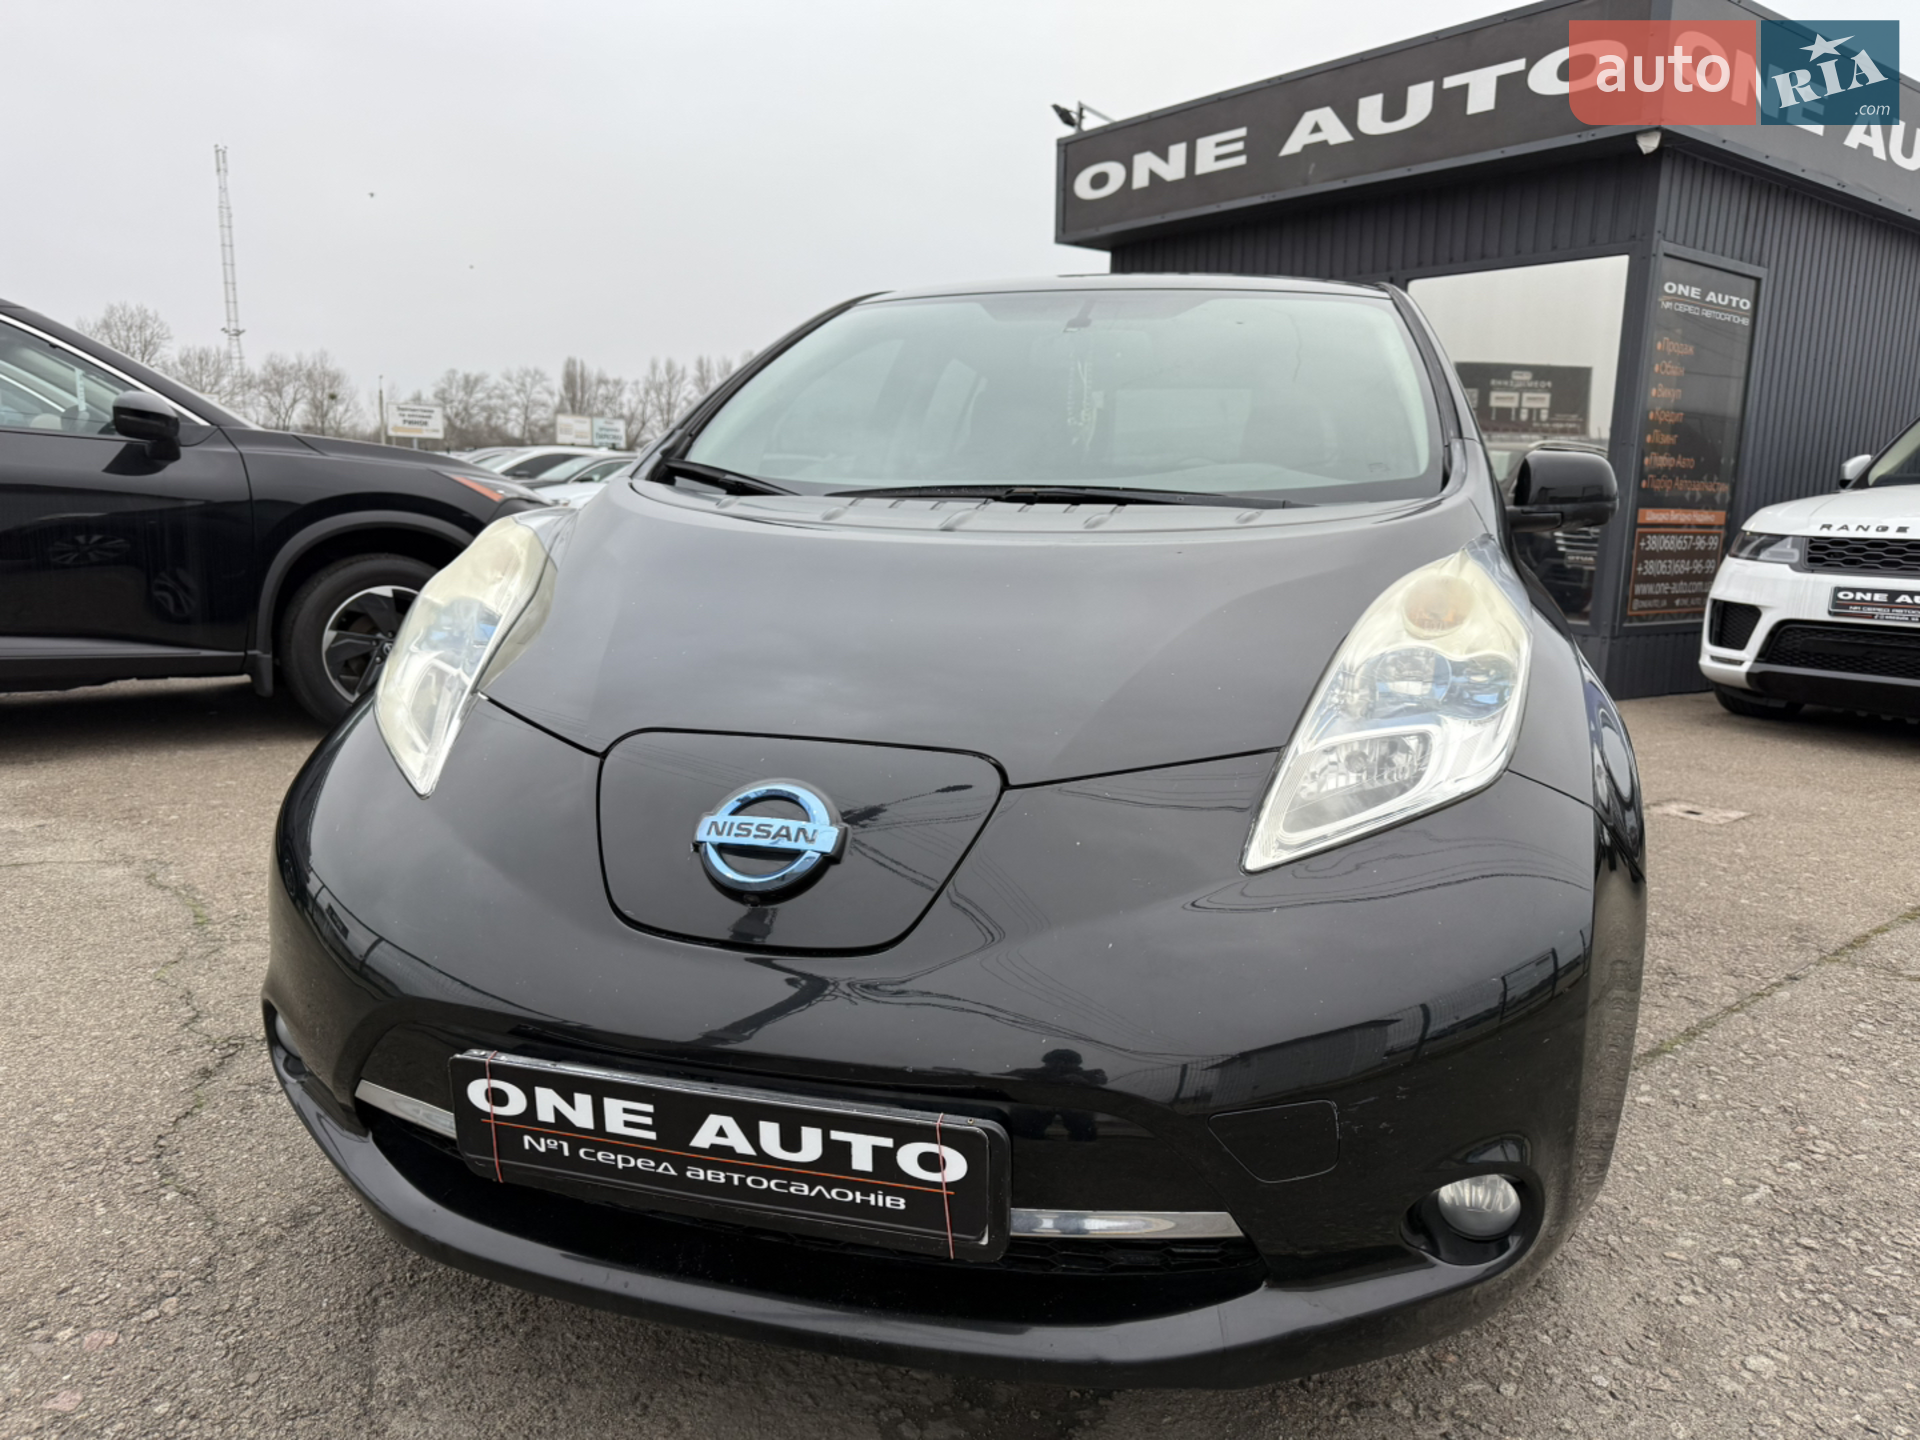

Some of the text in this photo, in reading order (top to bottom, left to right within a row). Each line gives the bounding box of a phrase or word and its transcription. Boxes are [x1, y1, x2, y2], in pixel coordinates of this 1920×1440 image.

[1073, 40, 1628, 200] ONE AUTO
[1663, 282, 1751, 310] ONE AUTO
[1819, 523, 1911, 534] RANGE
[1837, 591, 1888, 602] ONE
[706, 821, 818, 843] NISSAN
[466, 1078, 968, 1183] ONE AUTO
[523, 1134, 907, 1210] №1 серед автосалонів
